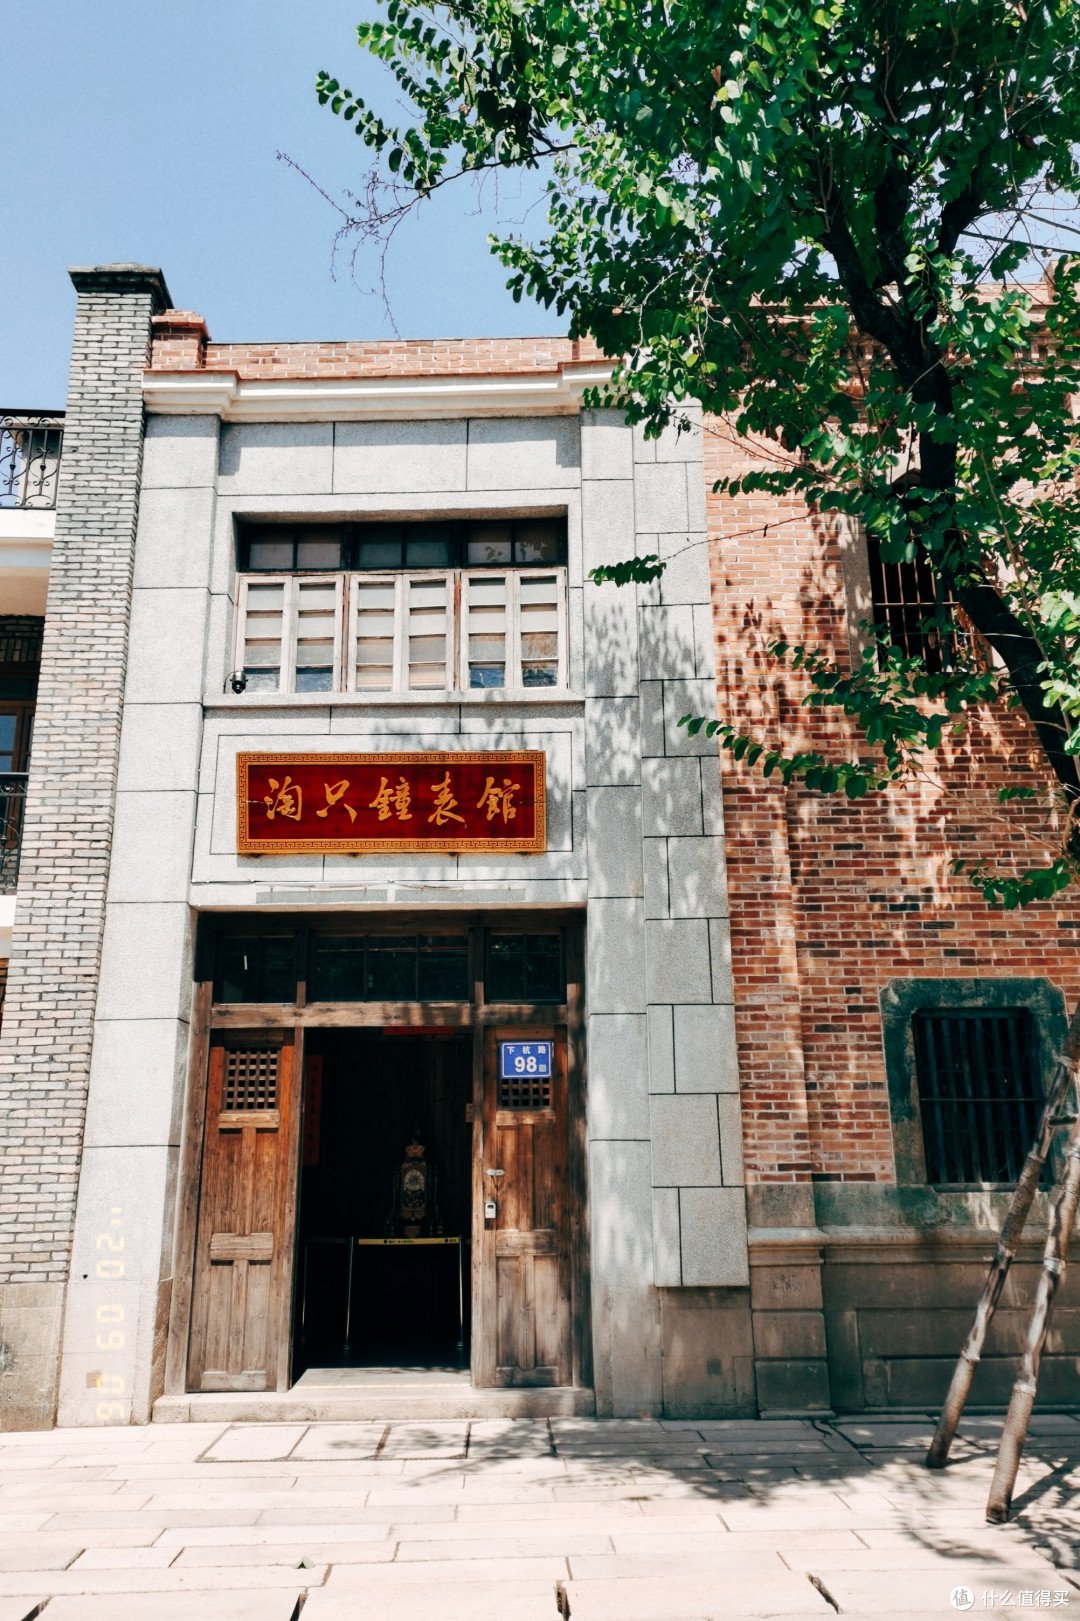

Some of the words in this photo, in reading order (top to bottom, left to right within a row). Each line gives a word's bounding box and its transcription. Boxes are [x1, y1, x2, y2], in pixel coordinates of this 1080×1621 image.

[506, 1045, 547, 1055] 下杭路
[514, 1056, 537, 1073] 98
